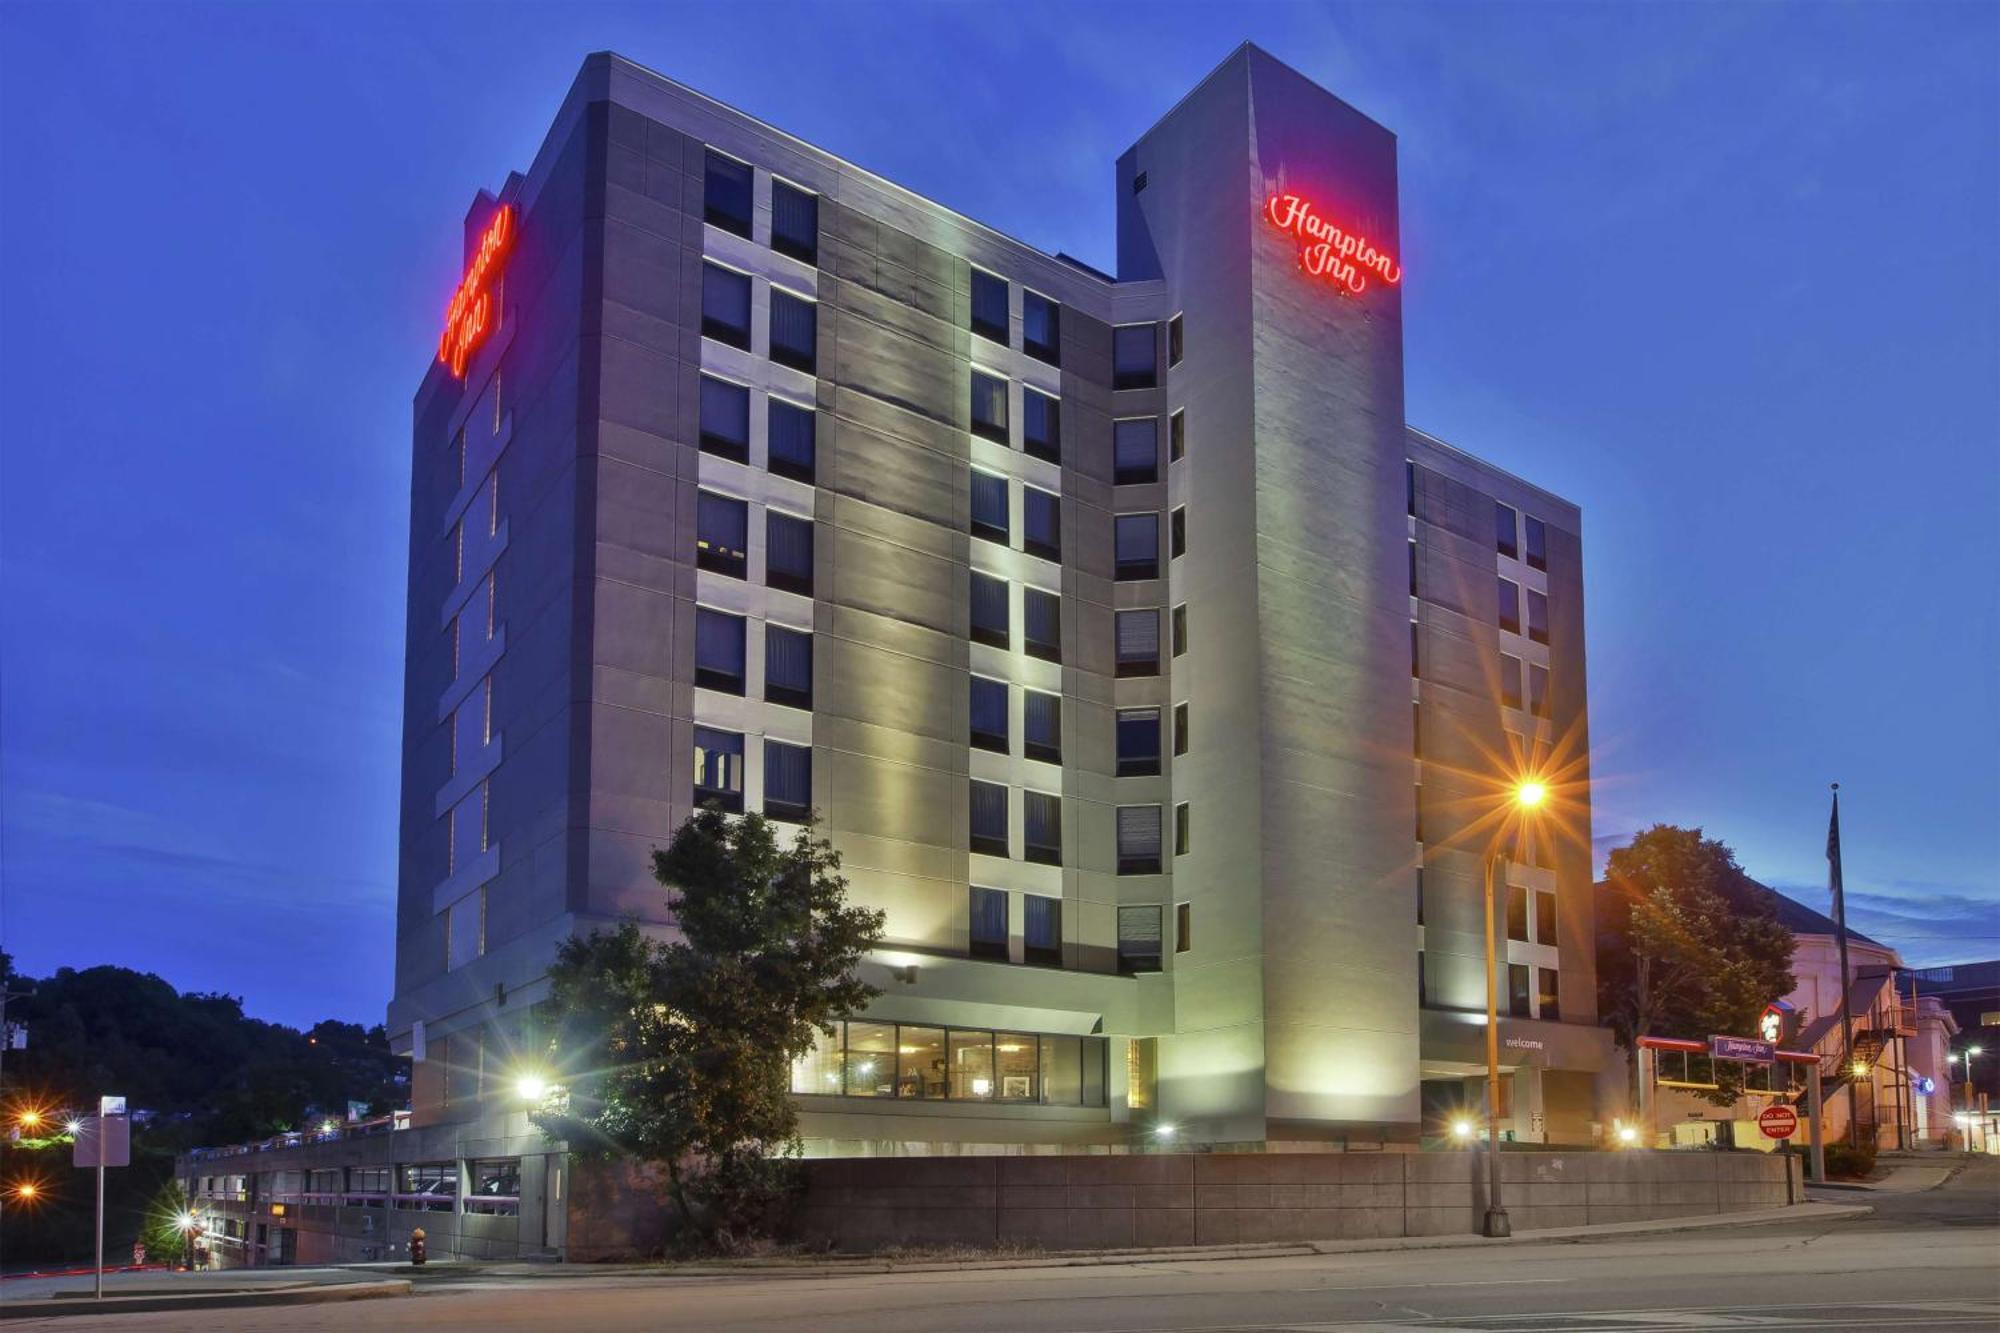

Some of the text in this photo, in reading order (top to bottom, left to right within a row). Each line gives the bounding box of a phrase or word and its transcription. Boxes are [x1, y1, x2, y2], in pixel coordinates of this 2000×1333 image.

[1270, 195, 1400, 283] Hampton
[1304, 243, 1366, 293] Inn
[1506, 1037, 1543, 1049] welcome
